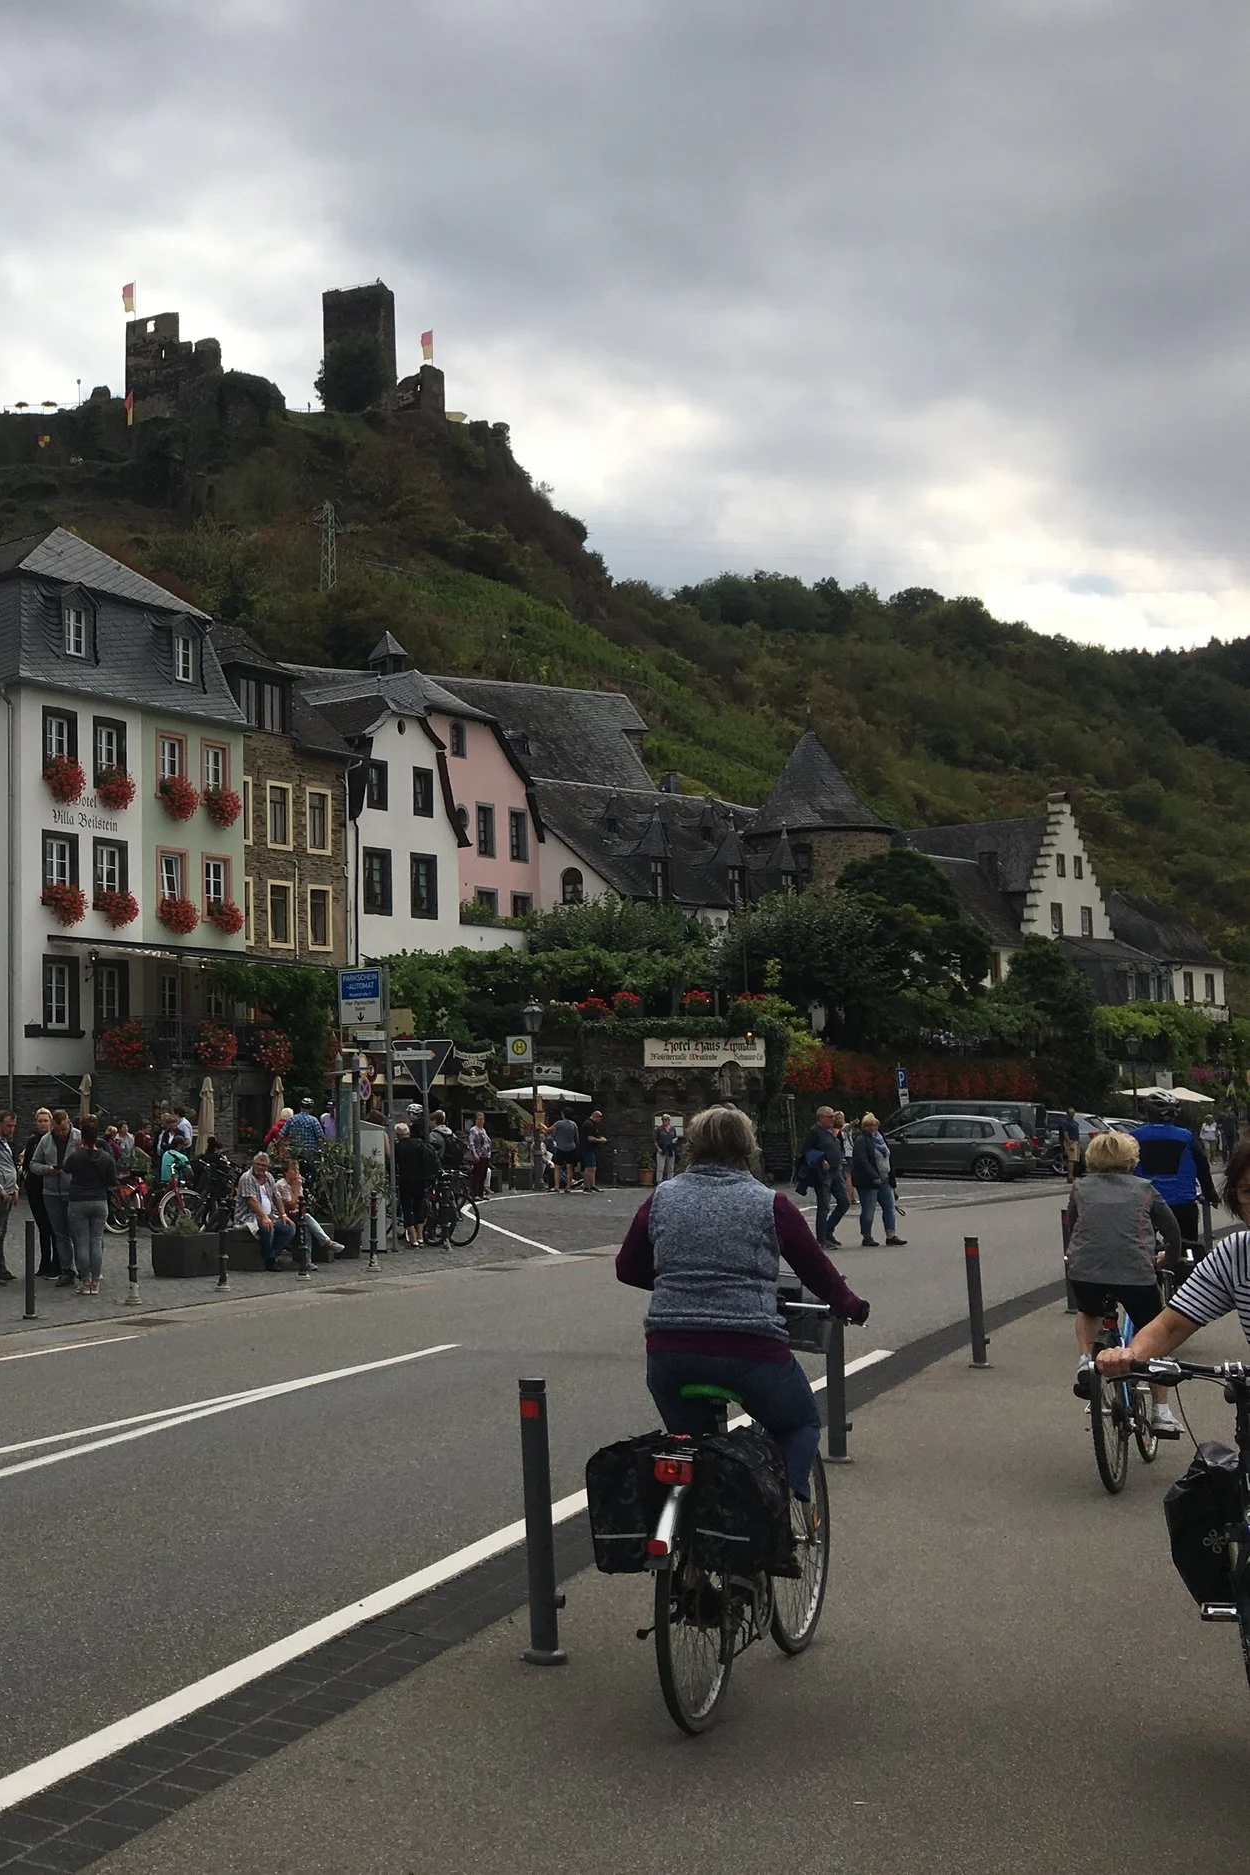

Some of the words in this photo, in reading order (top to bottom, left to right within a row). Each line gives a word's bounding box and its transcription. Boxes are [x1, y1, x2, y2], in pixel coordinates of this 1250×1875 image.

[52, 809, 74, 825] Villa
[78, 812, 118, 832] Beilstein
[342, 973, 378, 982] PARKSCHEIN
[664, 1039, 690, 1053] Hotel
[694, 1040, 720, 1053] Haus
[898, 1071, 905, 1087] P
